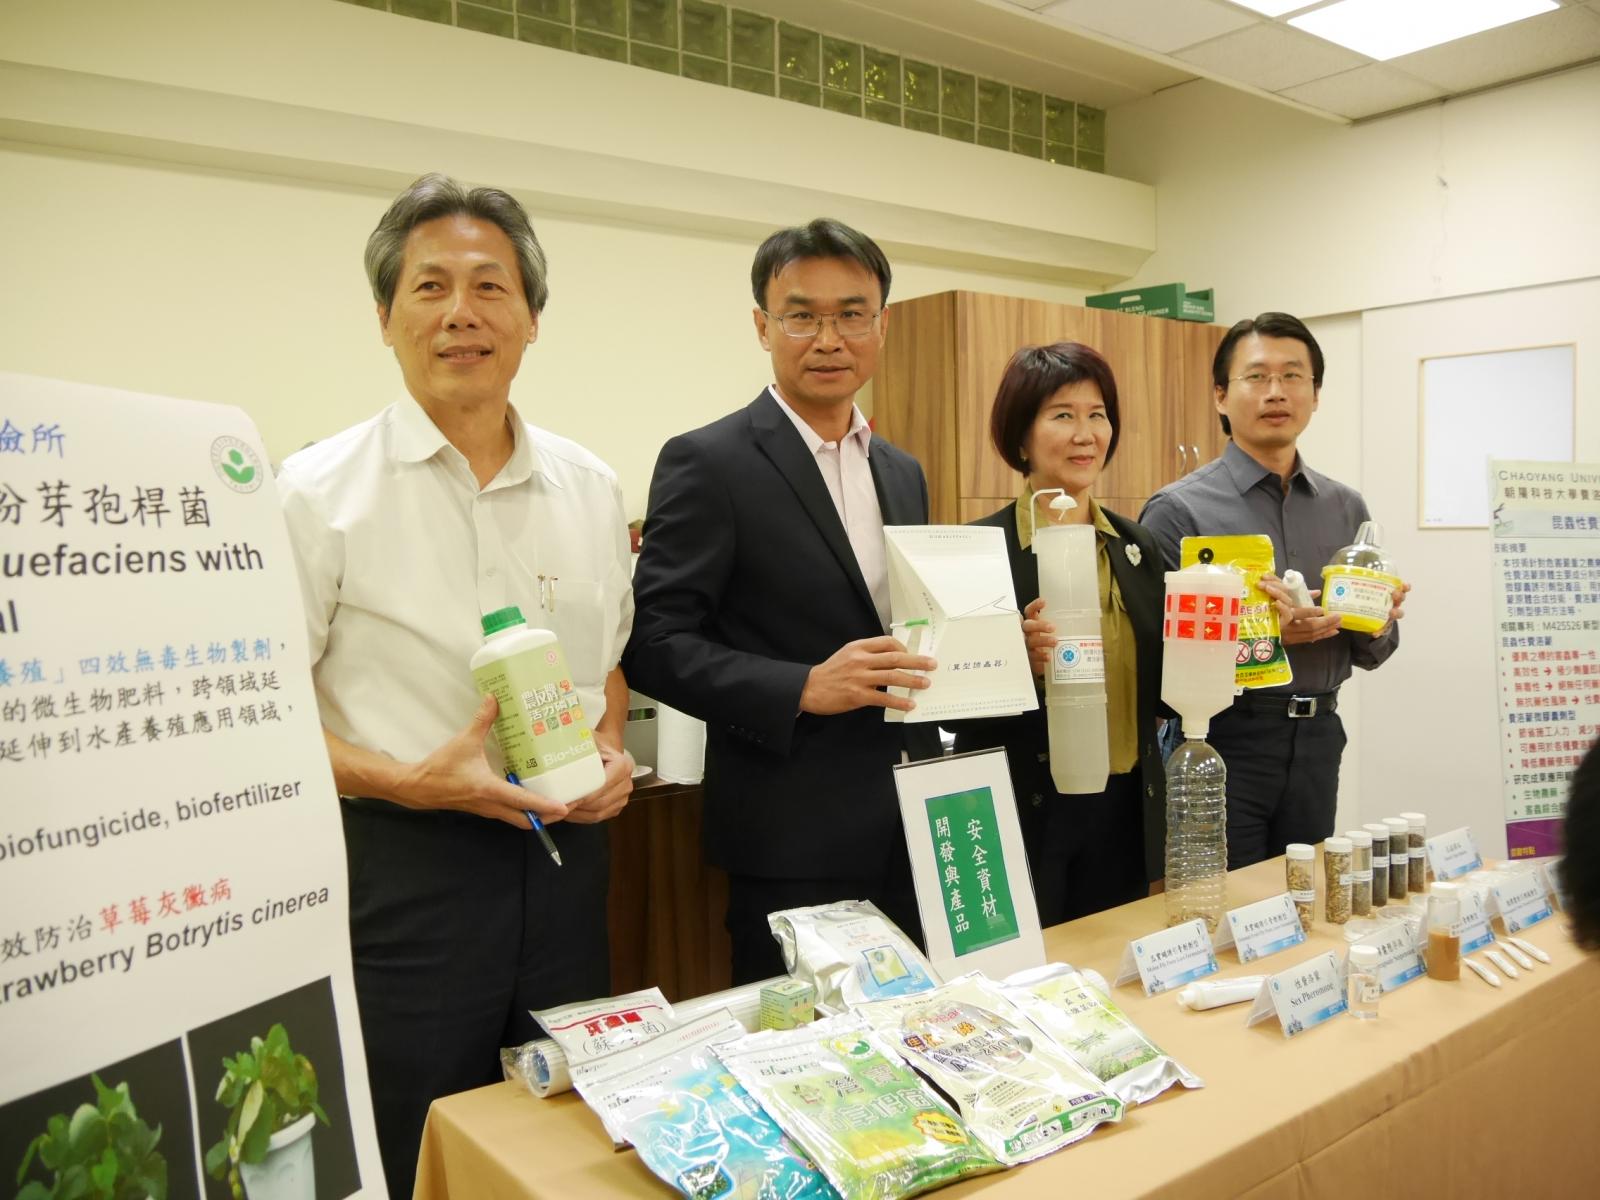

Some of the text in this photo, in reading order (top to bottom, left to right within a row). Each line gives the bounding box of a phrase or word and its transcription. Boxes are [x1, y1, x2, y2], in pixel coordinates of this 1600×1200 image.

[1498, 470, 1600, 483] CHAOYANG UNIV
[3, 542, 264, 577] uefaciens with
[177, 780, 301, 821] biofertilizer
[935, 816, 970, 933] 開發與產品
[966, 818, 997, 918] 安全資材
[0, 886, 329, 1004] rawberry Botrytis cinerea
